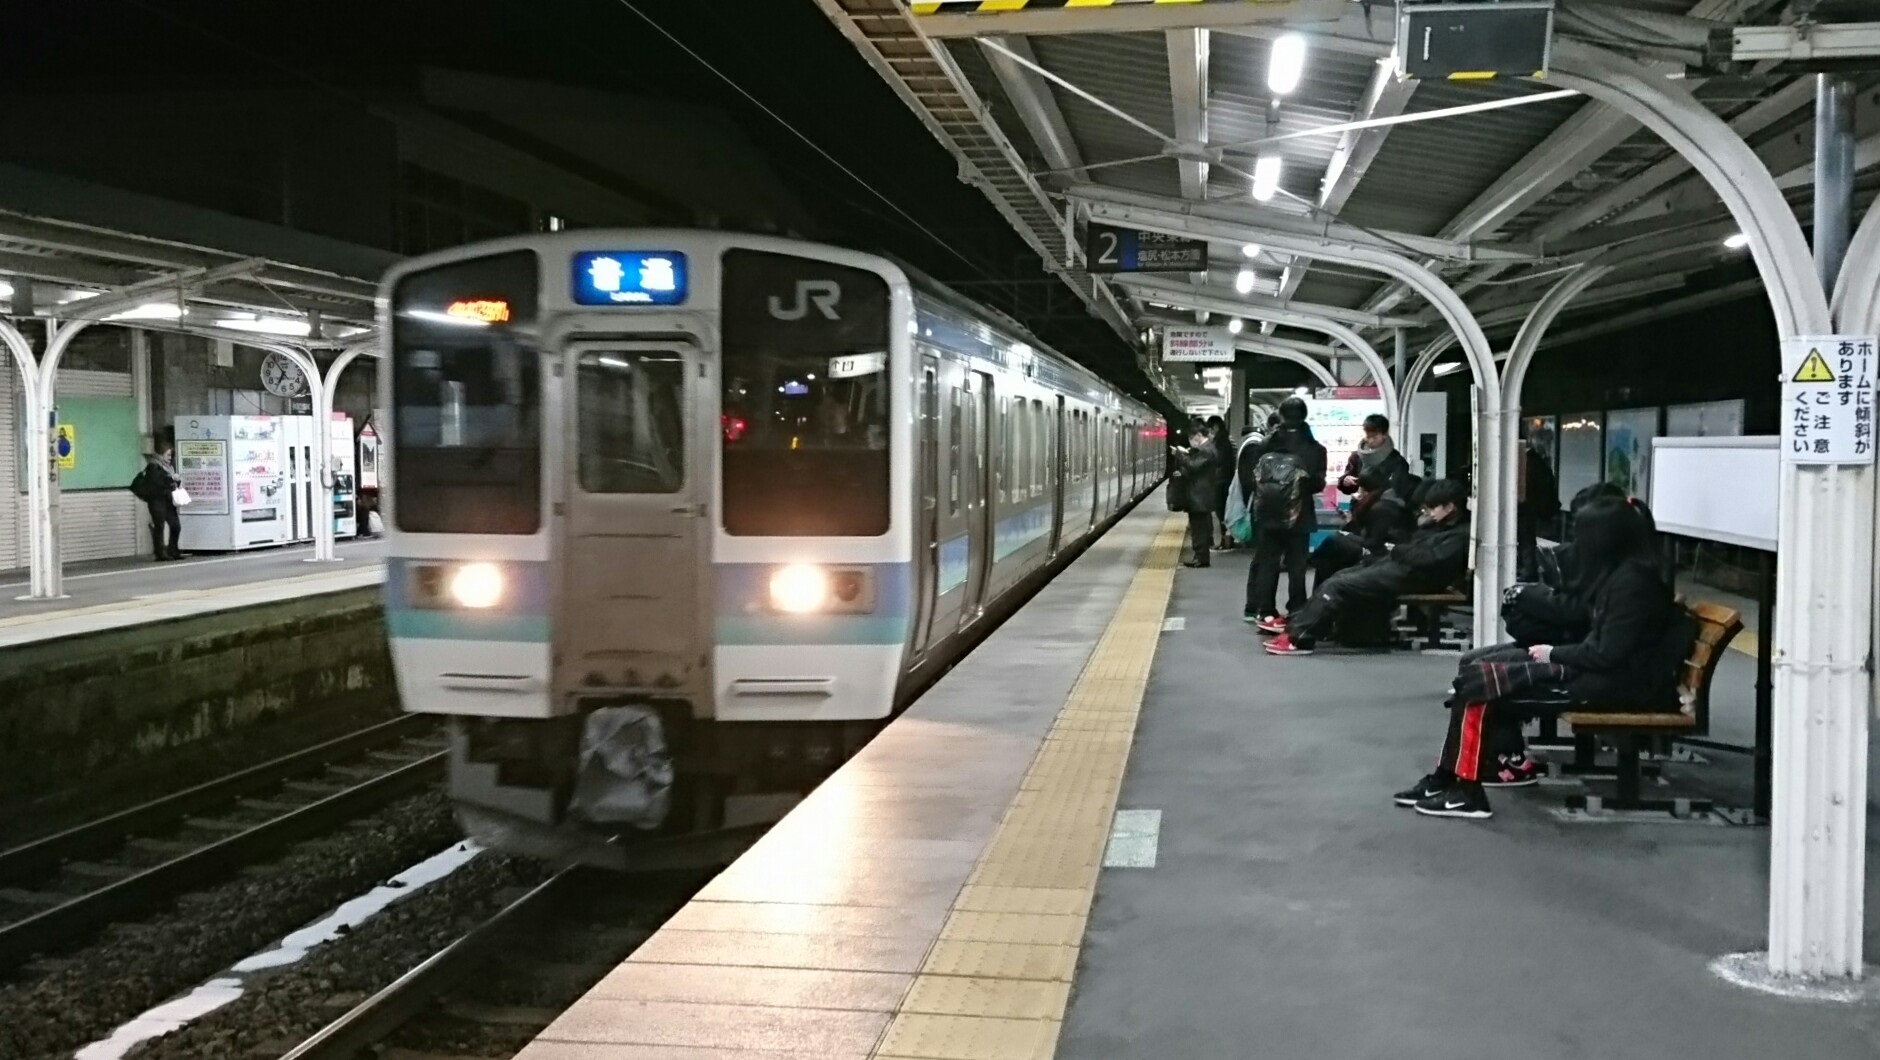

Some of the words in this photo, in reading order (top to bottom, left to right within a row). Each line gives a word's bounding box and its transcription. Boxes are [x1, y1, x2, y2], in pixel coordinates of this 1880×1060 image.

[1098, 232, 1118, 264] 2
[768, 280, 842, 321] JR
[1837, 341, 1854, 406] あります
[1854, 342, 1872, 454] ホームに傾斜が
[1793, 391, 1810, 453] ください
[1813, 391, 1831, 454] ご注意
